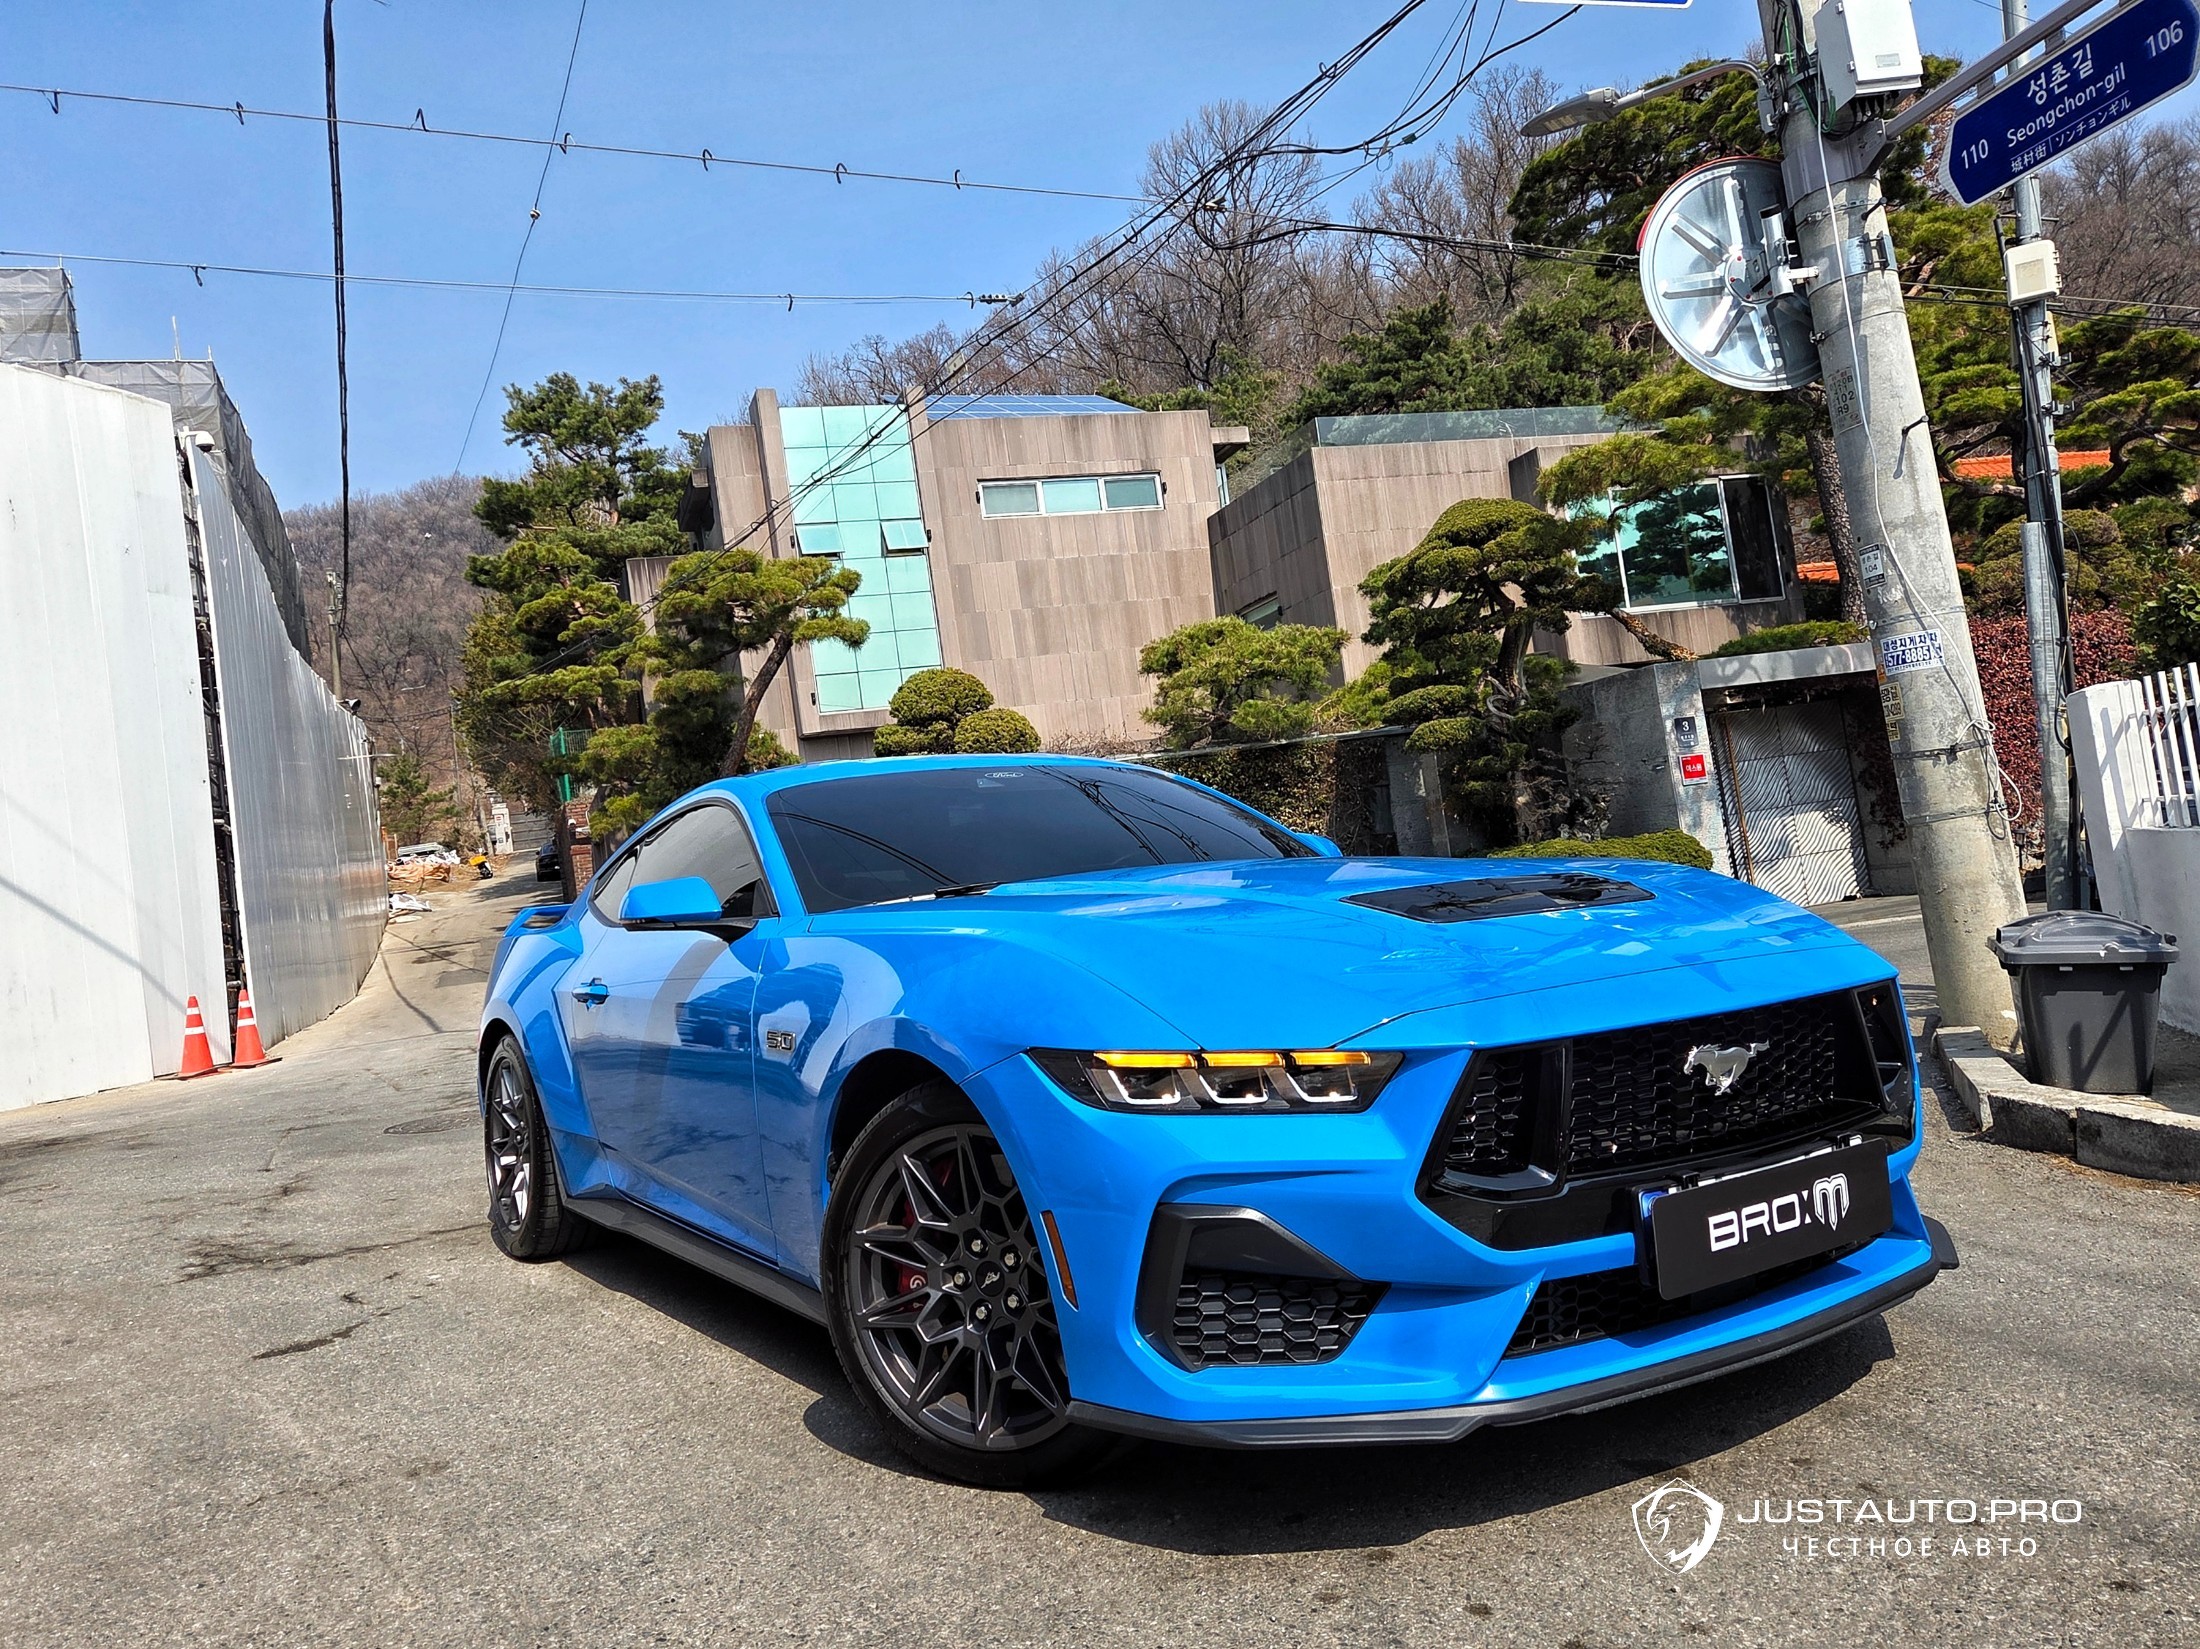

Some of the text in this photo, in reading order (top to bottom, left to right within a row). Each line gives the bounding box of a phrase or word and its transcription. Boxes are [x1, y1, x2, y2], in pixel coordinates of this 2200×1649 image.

[2145, 19, 2184, 58] 106
[2027, 43, 2094, 105] 성촌길
[2006, 61, 2126, 148] Seongchon-gil
[1960, 138, 1989, 169] 110
[1682, 721, 1689, 731] 3
